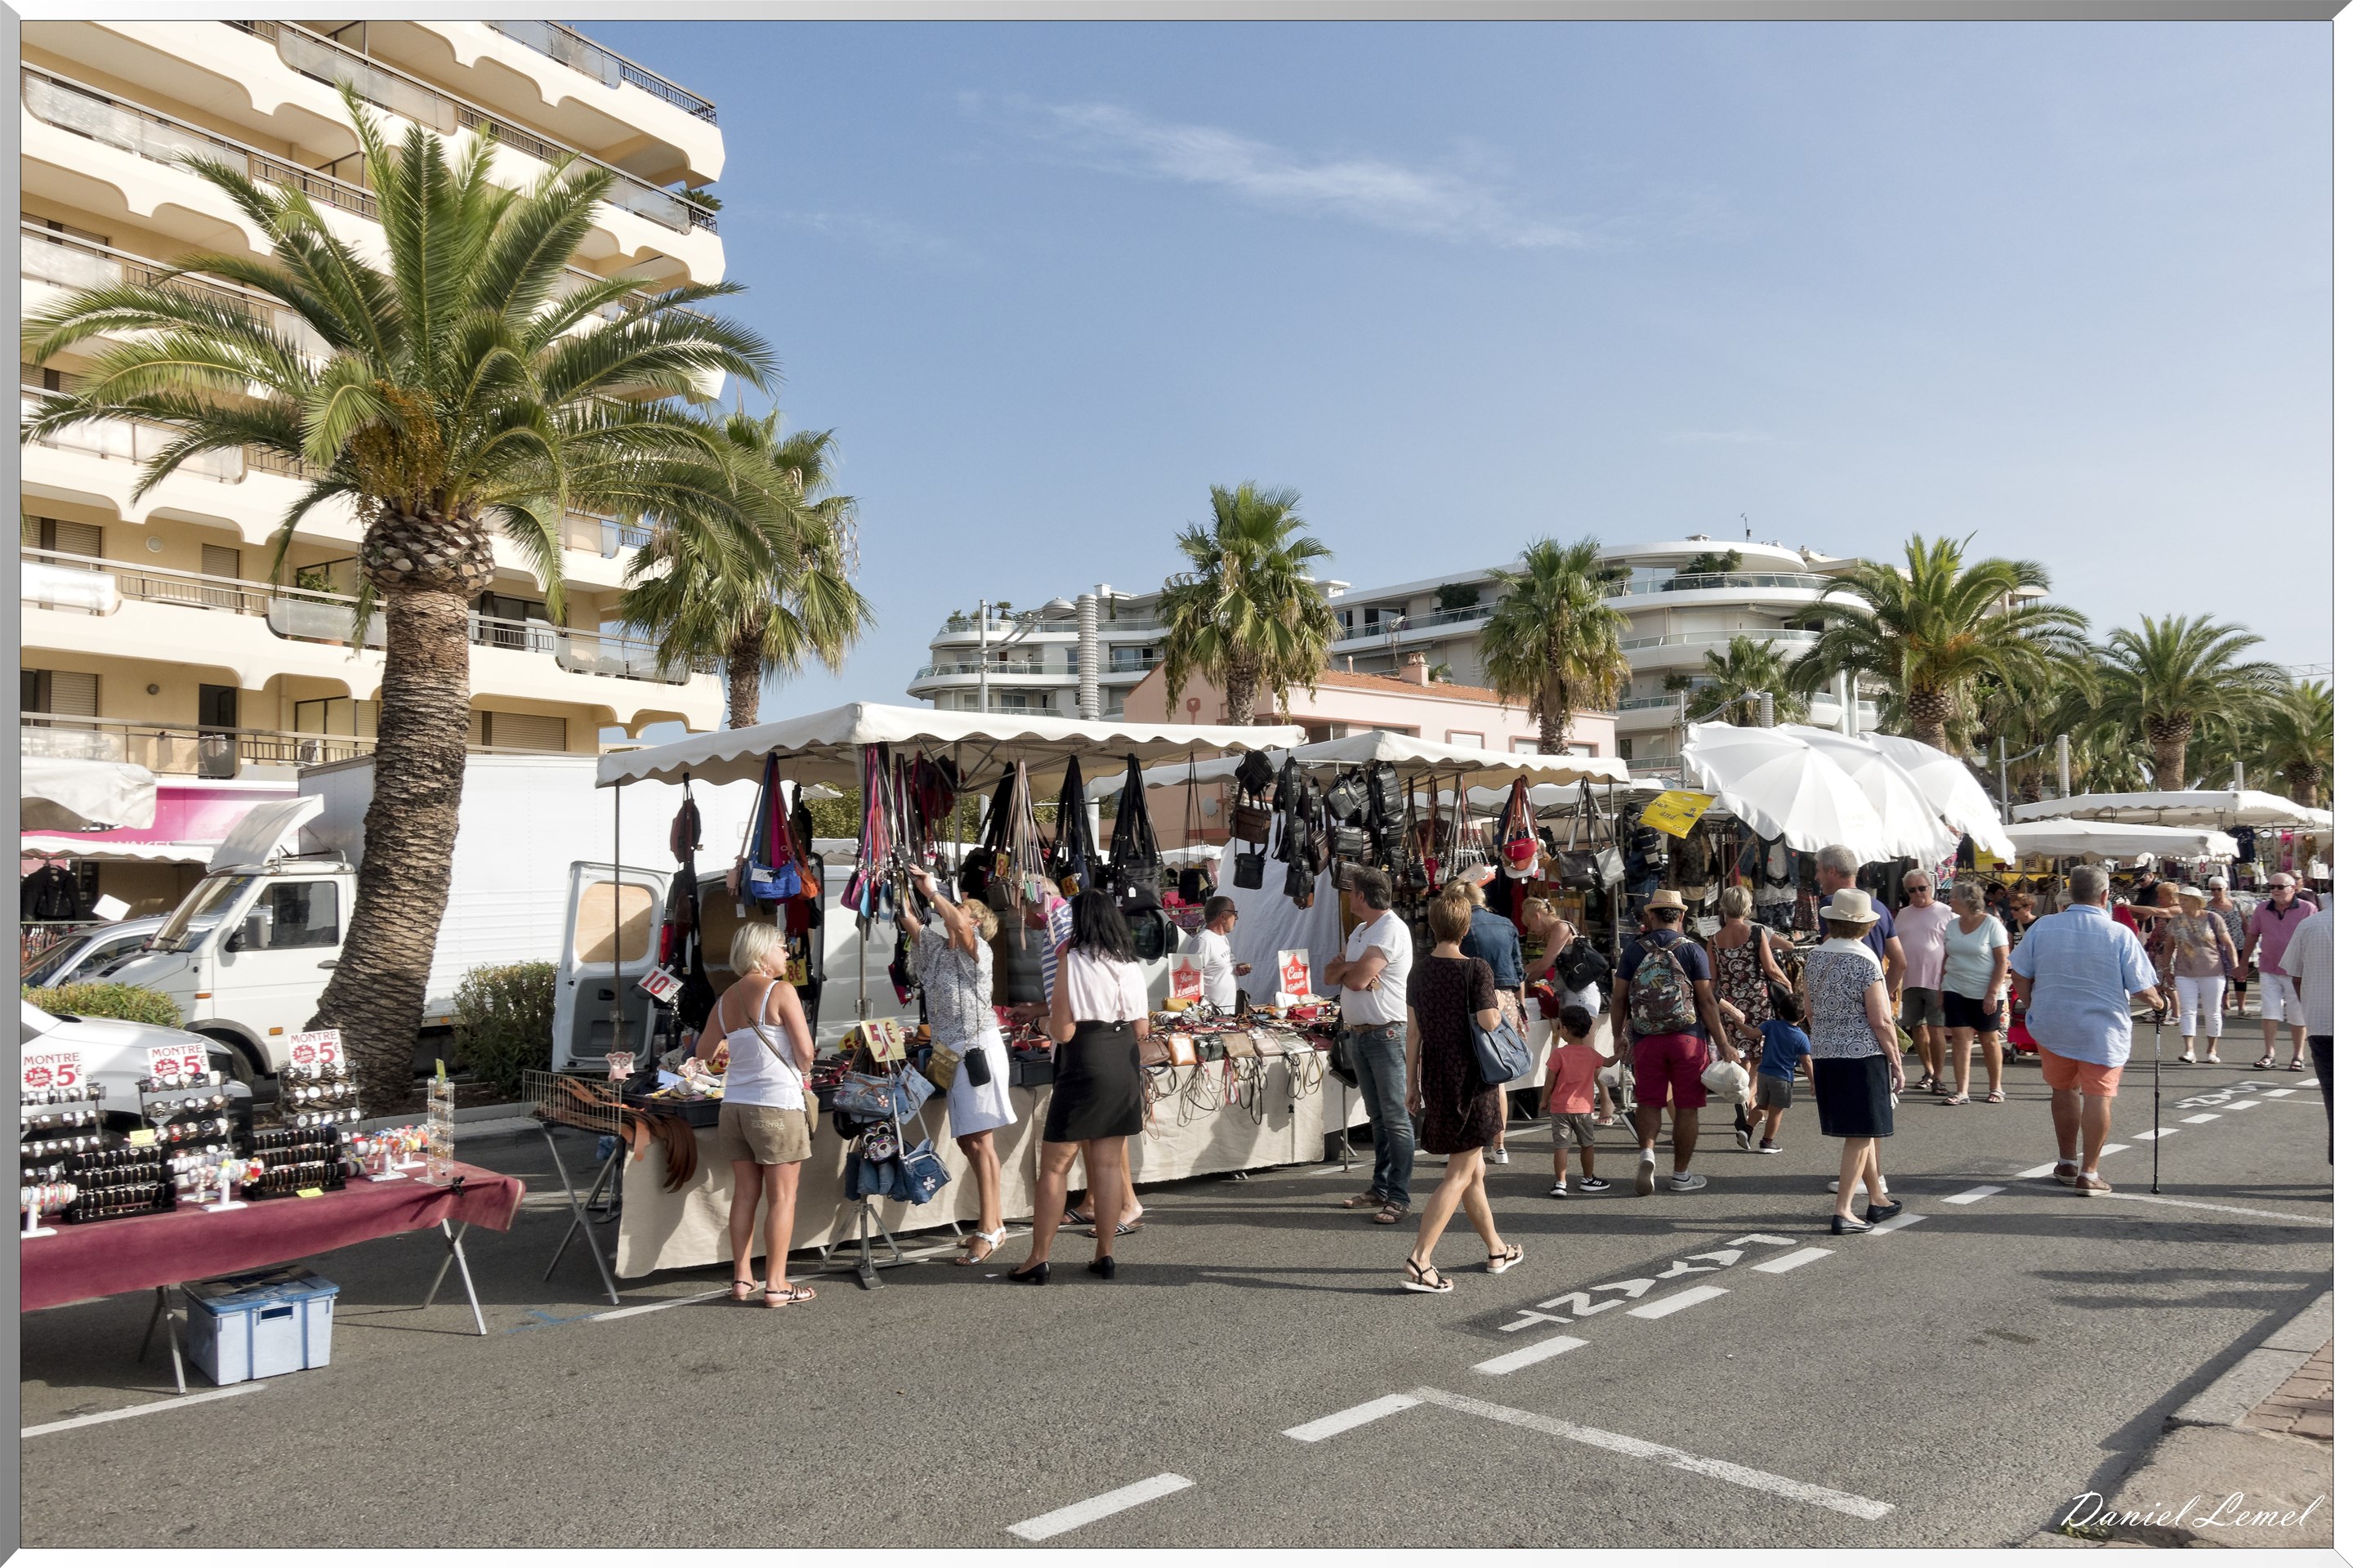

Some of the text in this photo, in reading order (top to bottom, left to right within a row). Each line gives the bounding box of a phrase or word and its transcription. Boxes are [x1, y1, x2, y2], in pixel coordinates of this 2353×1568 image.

[1659, 811, 1680, 820] and
[788, 965, 802, 982] 8€
[1287, 966, 1305, 981] Cuir
[1176, 984, 1199, 998] Leather
[288, 1030, 338, 1044] MONTRE
[151, 1044, 204, 1058] MONTRE
[24, 1052, 81, 1066] MONTRE
[1497, 1232, 1798, 1333] PAYANT
